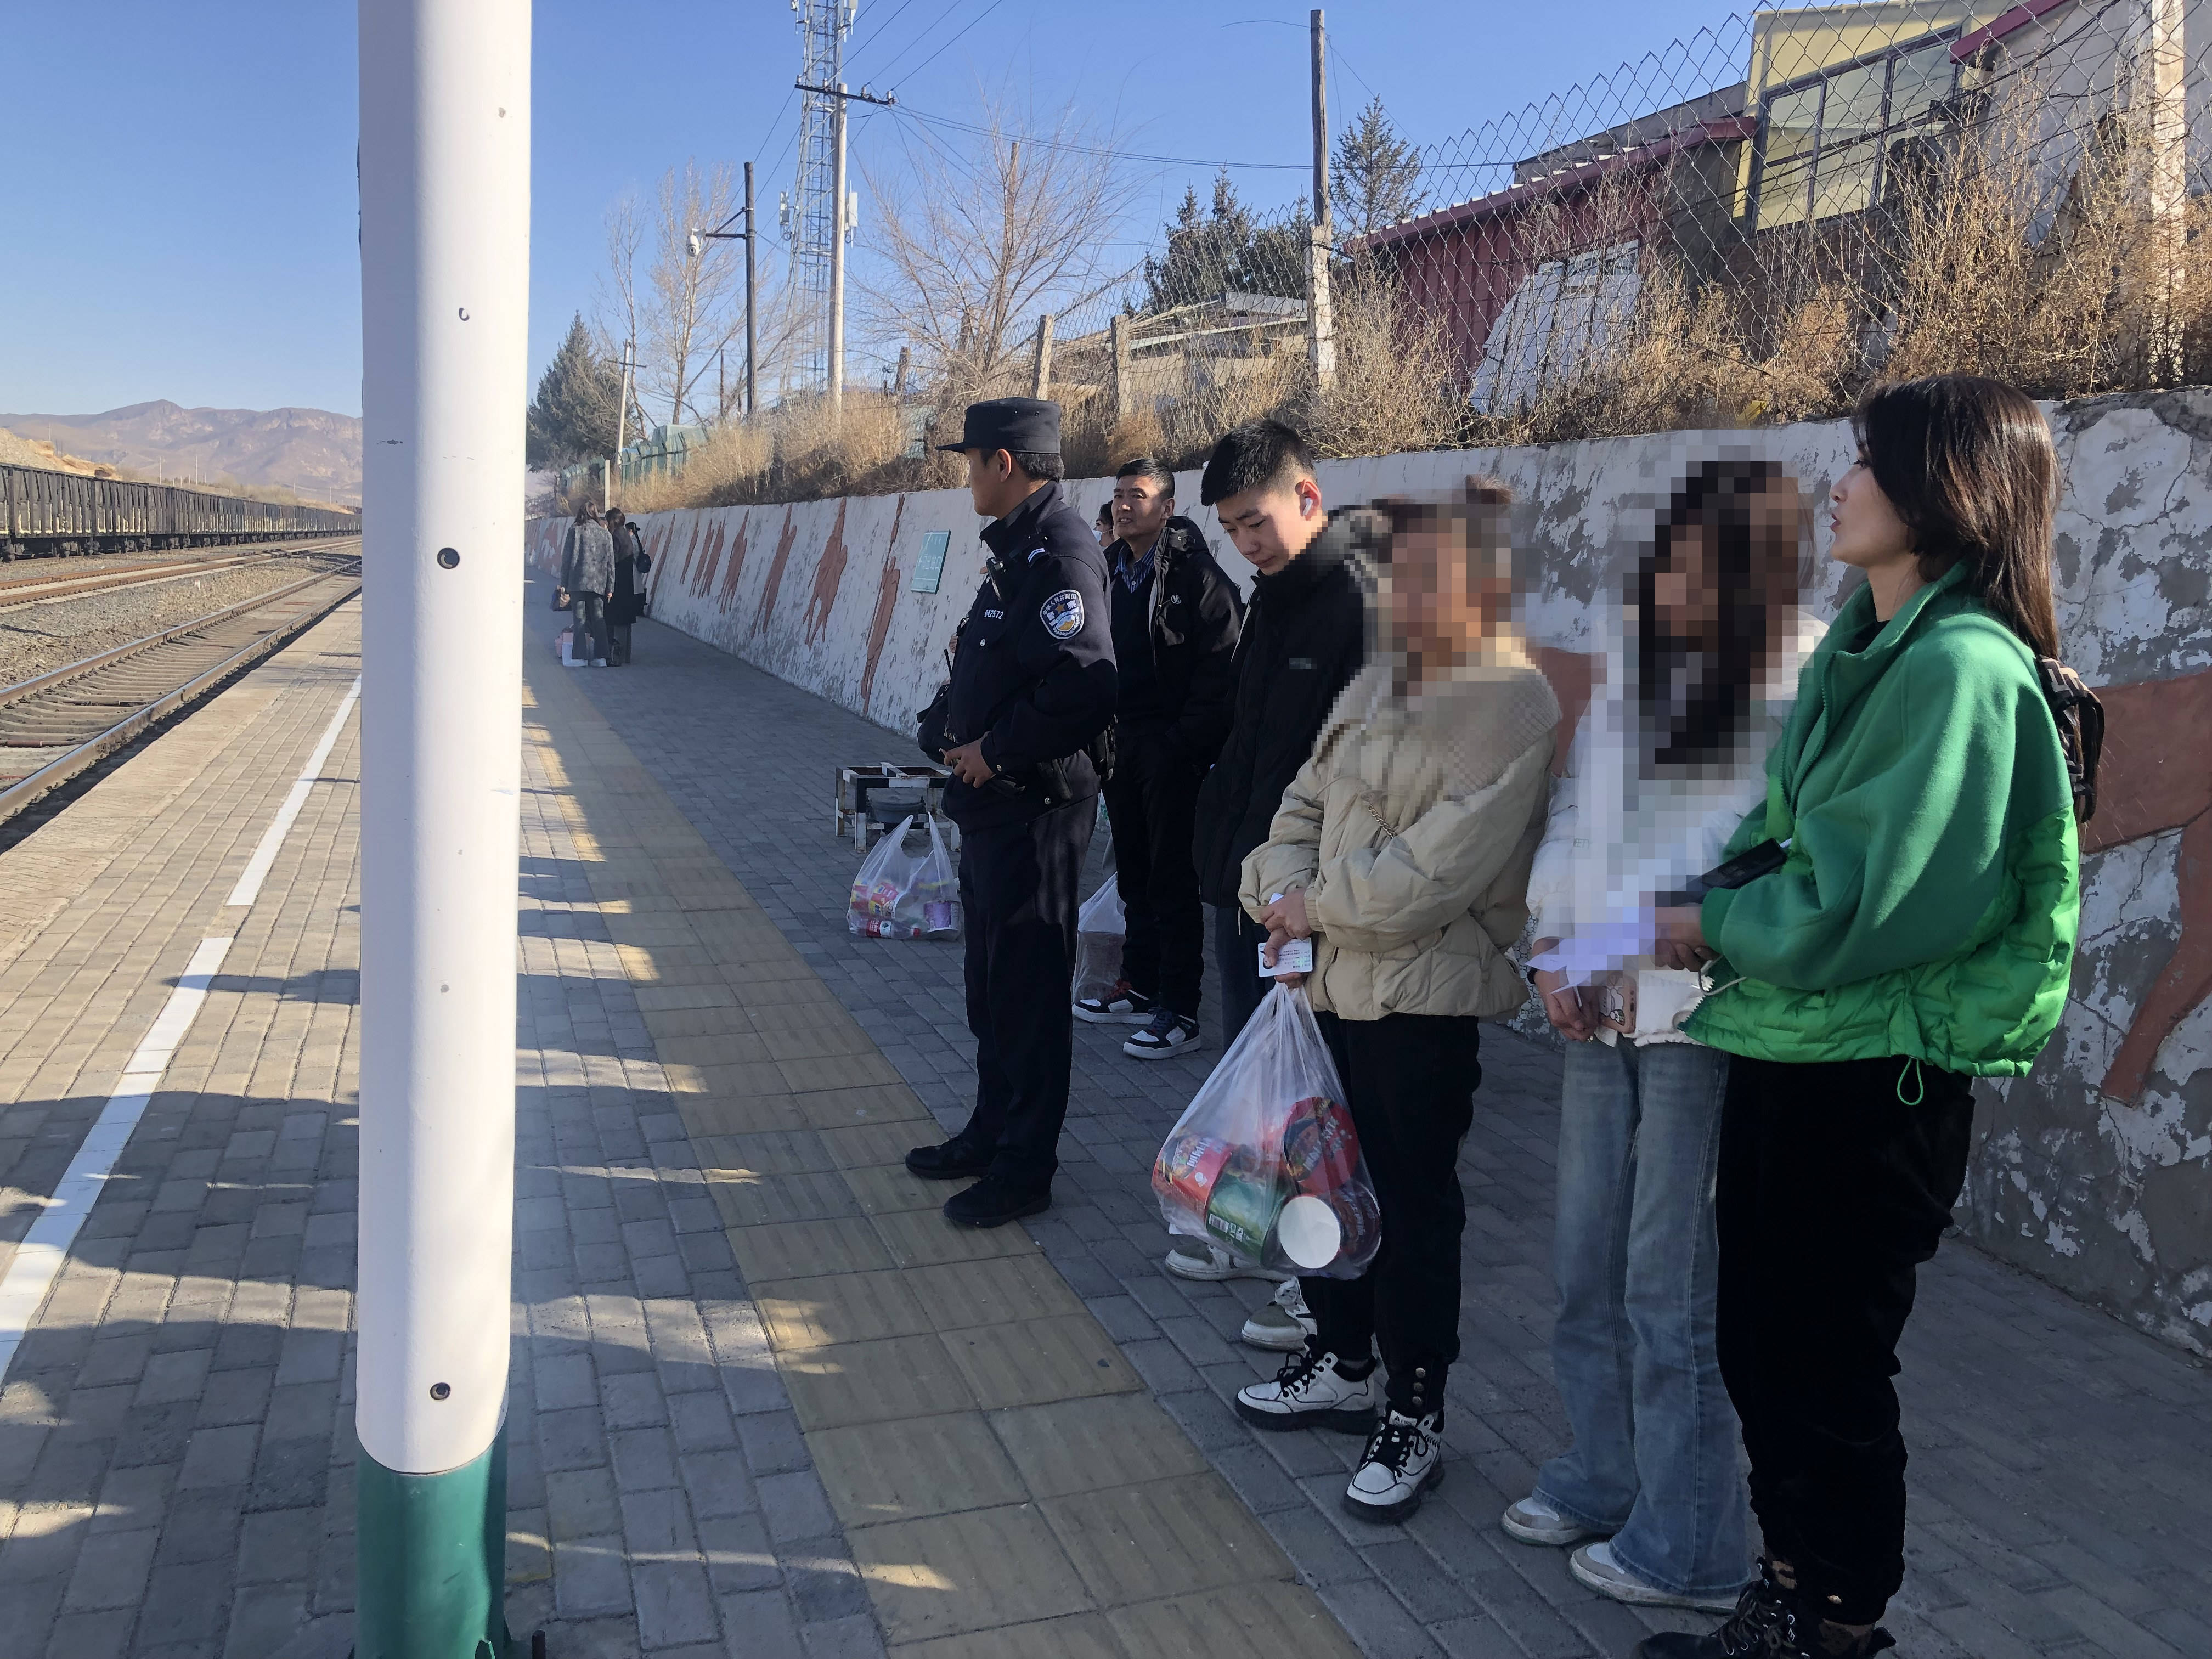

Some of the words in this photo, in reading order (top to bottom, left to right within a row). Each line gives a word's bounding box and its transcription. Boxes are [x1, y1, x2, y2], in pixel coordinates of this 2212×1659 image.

[1042, 593, 1076, 616] 中华人民共和国
